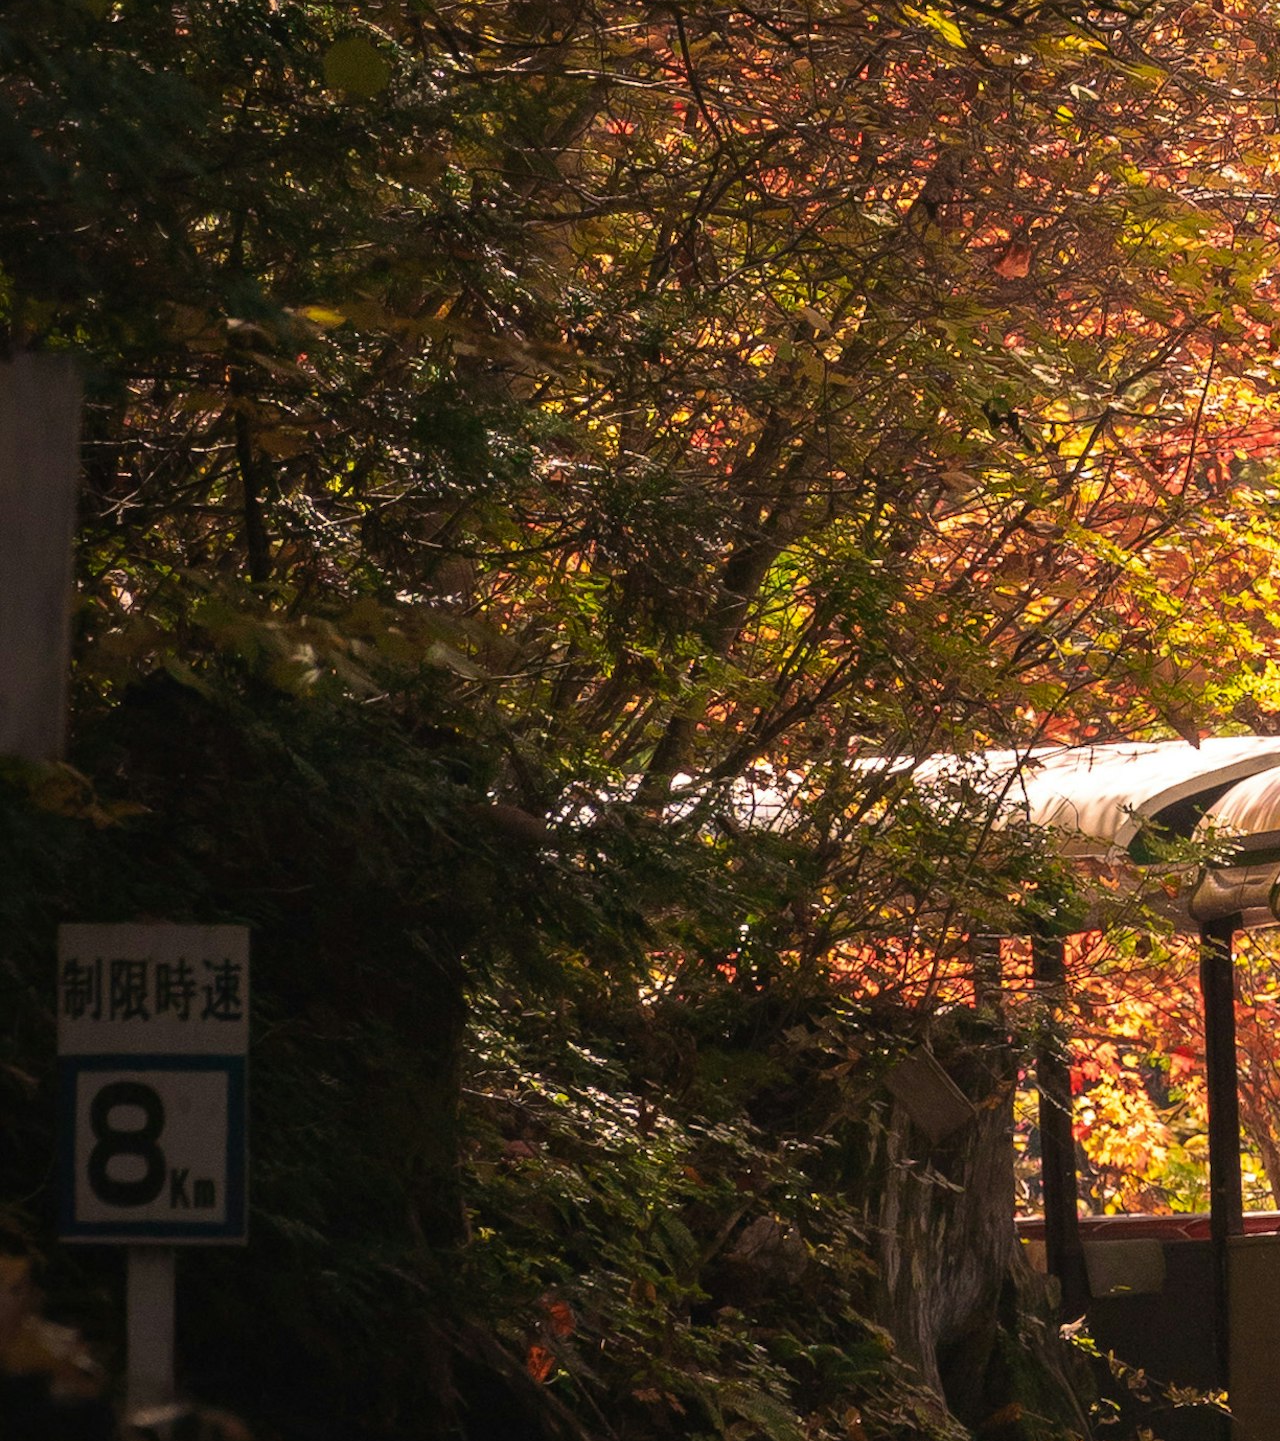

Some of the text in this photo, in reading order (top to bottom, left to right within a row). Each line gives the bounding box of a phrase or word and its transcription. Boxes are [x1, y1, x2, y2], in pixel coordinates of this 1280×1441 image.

[63, 958, 243, 1021] 制限時速
[88, 1081, 167, 1208] 8
